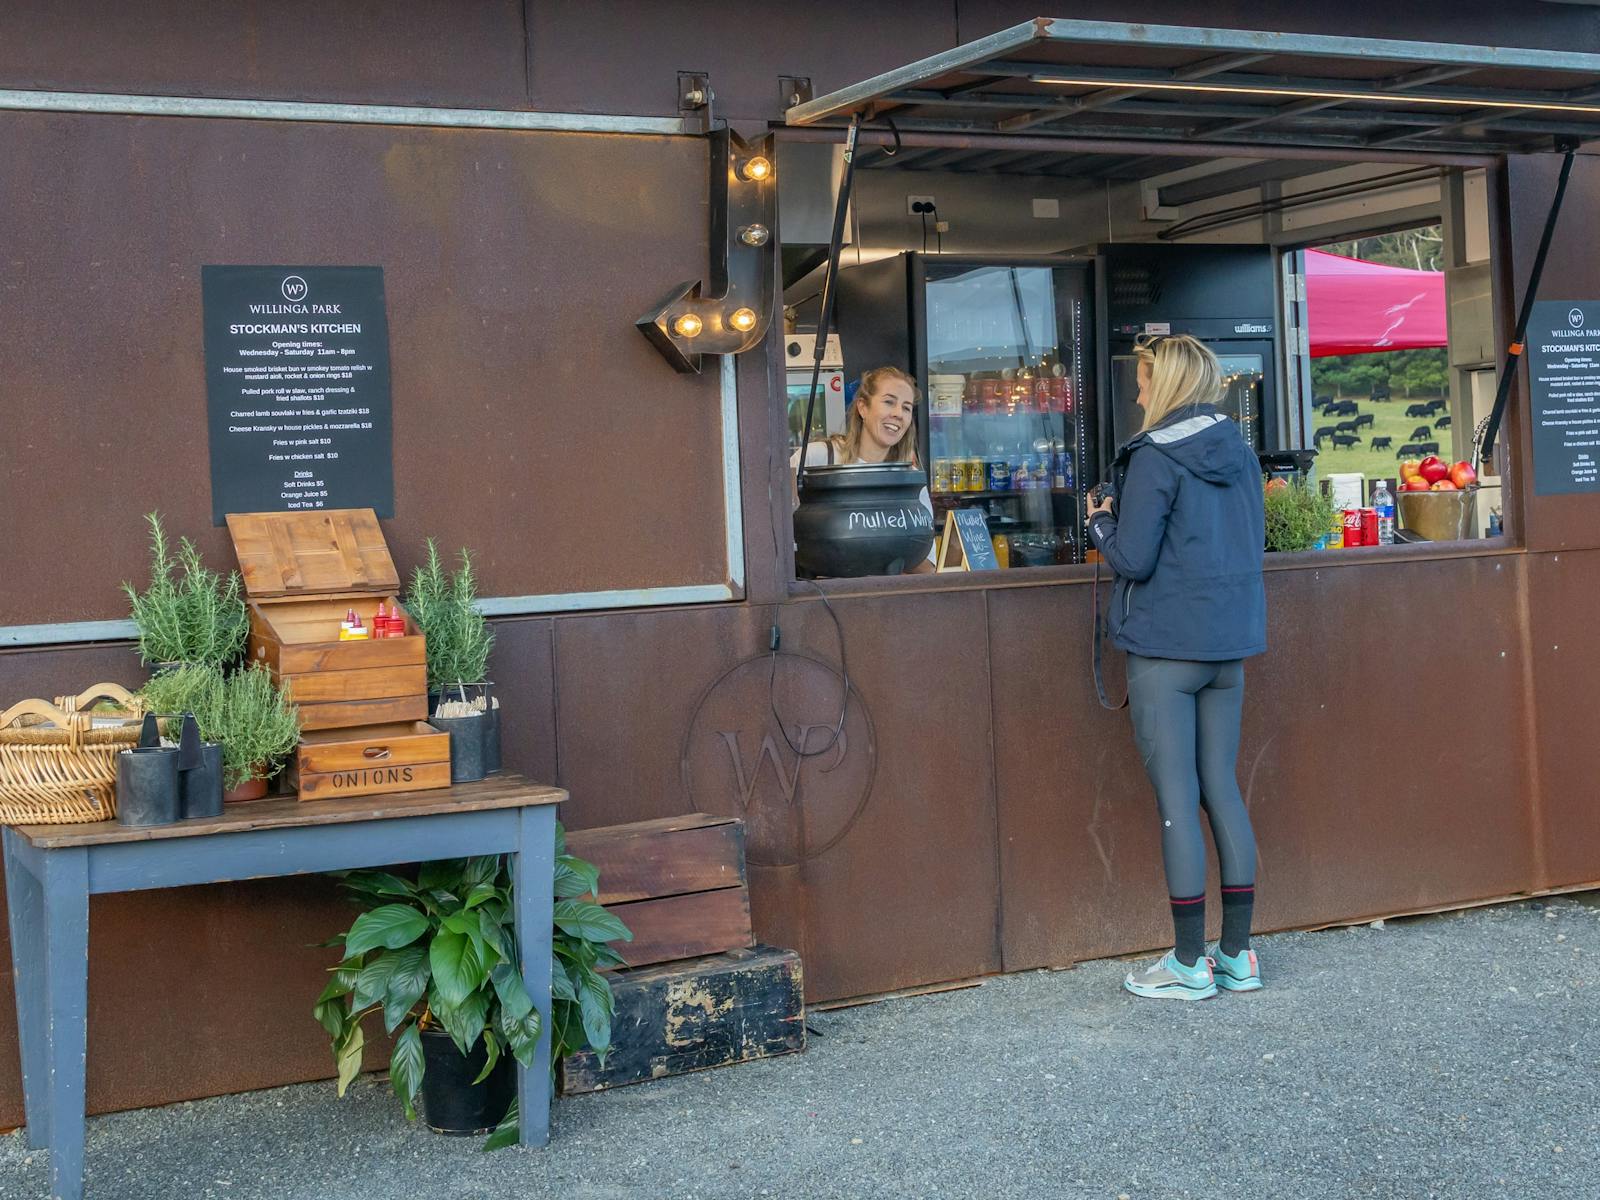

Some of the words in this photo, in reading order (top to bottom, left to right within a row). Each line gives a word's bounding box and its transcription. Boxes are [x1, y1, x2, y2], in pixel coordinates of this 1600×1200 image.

[249, 304, 309, 314] WILLINGA
[312, 304, 342, 314] PARK
[230, 324, 308, 334] STOCKMAN'S
[310, 323, 361, 334] KITCHEN
[1234, 323, 1267, 333] williams
[272, 341, 300, 350] Opening
[1541, 344, 1584, 352] STOCKMAN'S
[239, 349, 279, 357] Wednesday
[284, 348, 315, 357] Saturday
[307, 365, 329, 373] smokey
[261, 388, 275, 396] pork
[325, 386, 350, 394] dressing
[849, 509, 908, 531] Mulled
[332, 767, 413, 788] ONIONS
